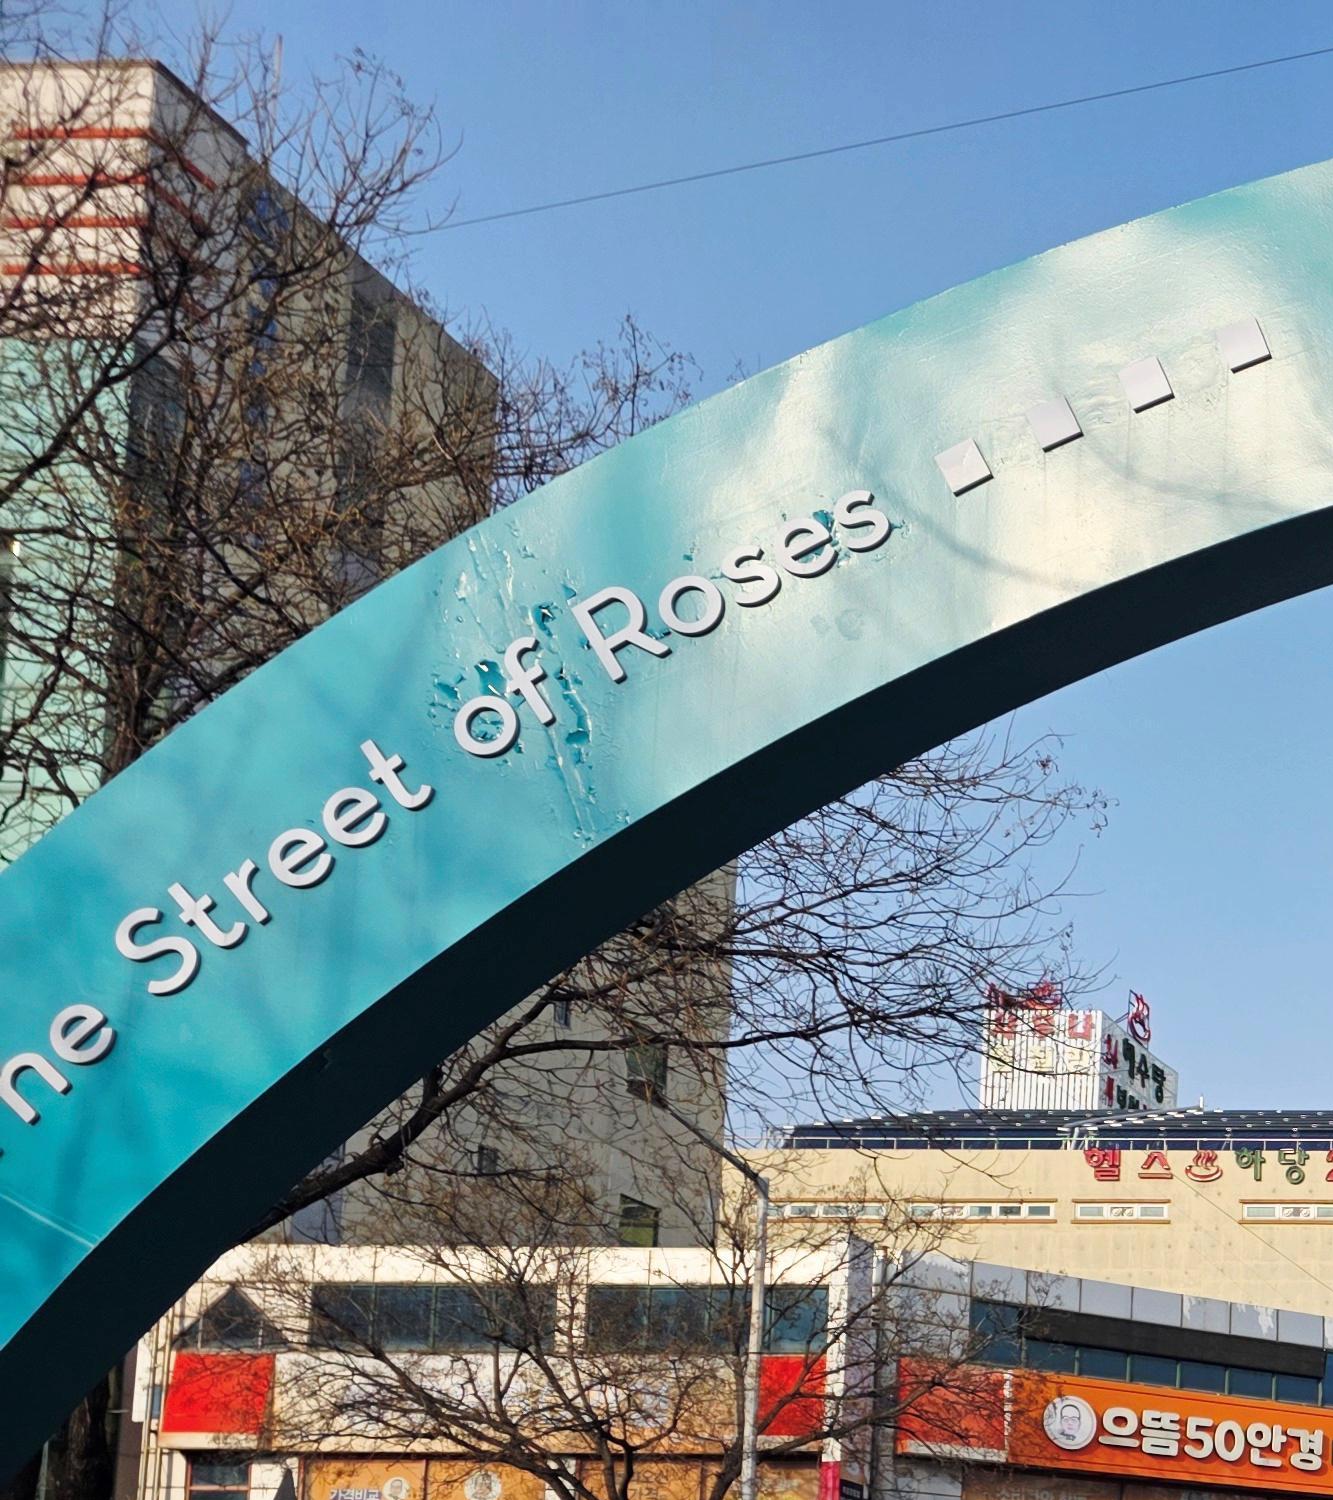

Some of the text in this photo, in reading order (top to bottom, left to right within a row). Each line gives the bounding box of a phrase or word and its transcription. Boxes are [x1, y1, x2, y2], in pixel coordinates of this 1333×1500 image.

[115, 488, 894, 996] Street of Roses
[1085, 1149, 1174, 1182] 헬스
[1235, 1148, 1310, 1185] 하당
[1099, 1407, 1324, 1471] 으뜸50안경
